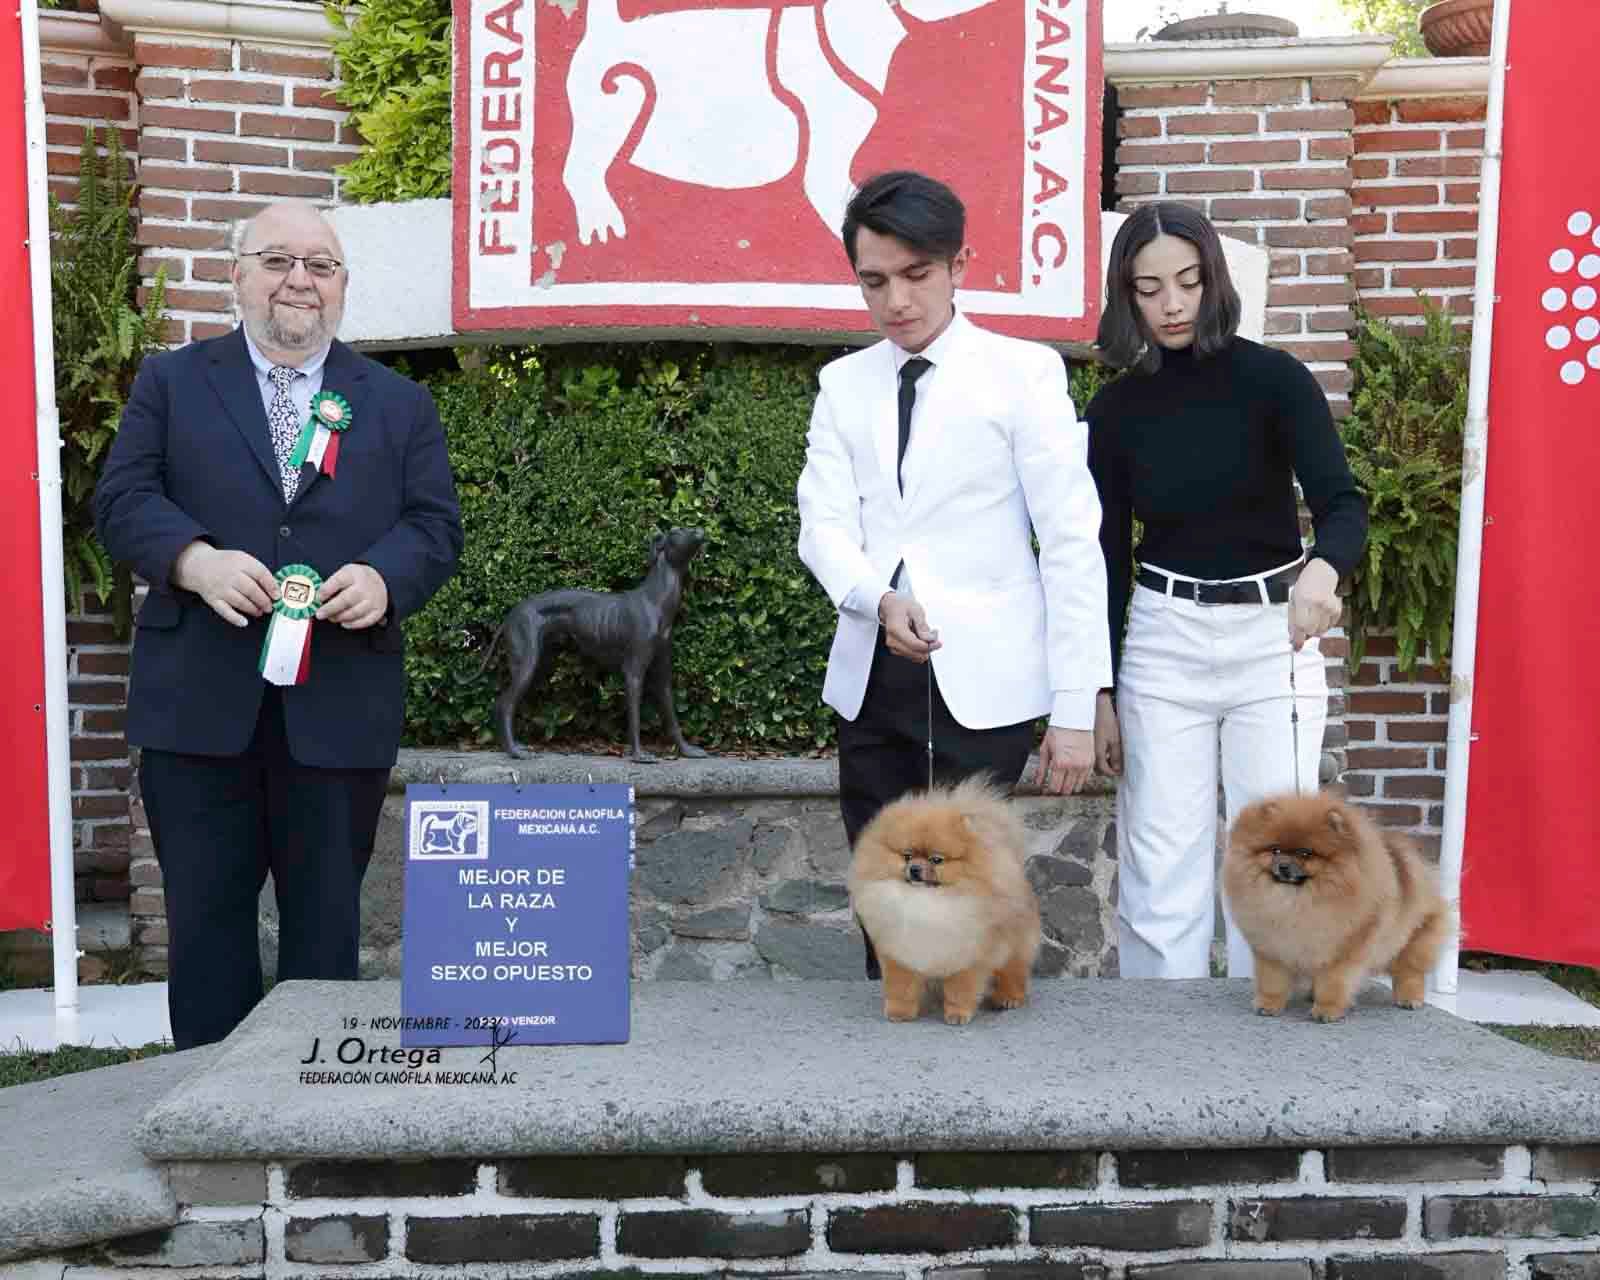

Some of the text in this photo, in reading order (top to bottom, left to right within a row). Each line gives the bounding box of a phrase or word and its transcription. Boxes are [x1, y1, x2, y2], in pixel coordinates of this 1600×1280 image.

[1028, 0, 1070, 286] ANA, A.C.
[494, 809, 624, 820] FEDERACION CANOFILA
[518, 823, 600, 834] MEXICANA A.C.
[459, 869, 565, 885] MEJOR DE
[468, 894, 556, 909] LA RAZA
[505, 917, 519, 933] Y
[475, 941, 548, 957] MEJOR
[431, 965, 592, 981] SEXO OPUESTO
[512, 1015, 557, 1025] VENZOR
